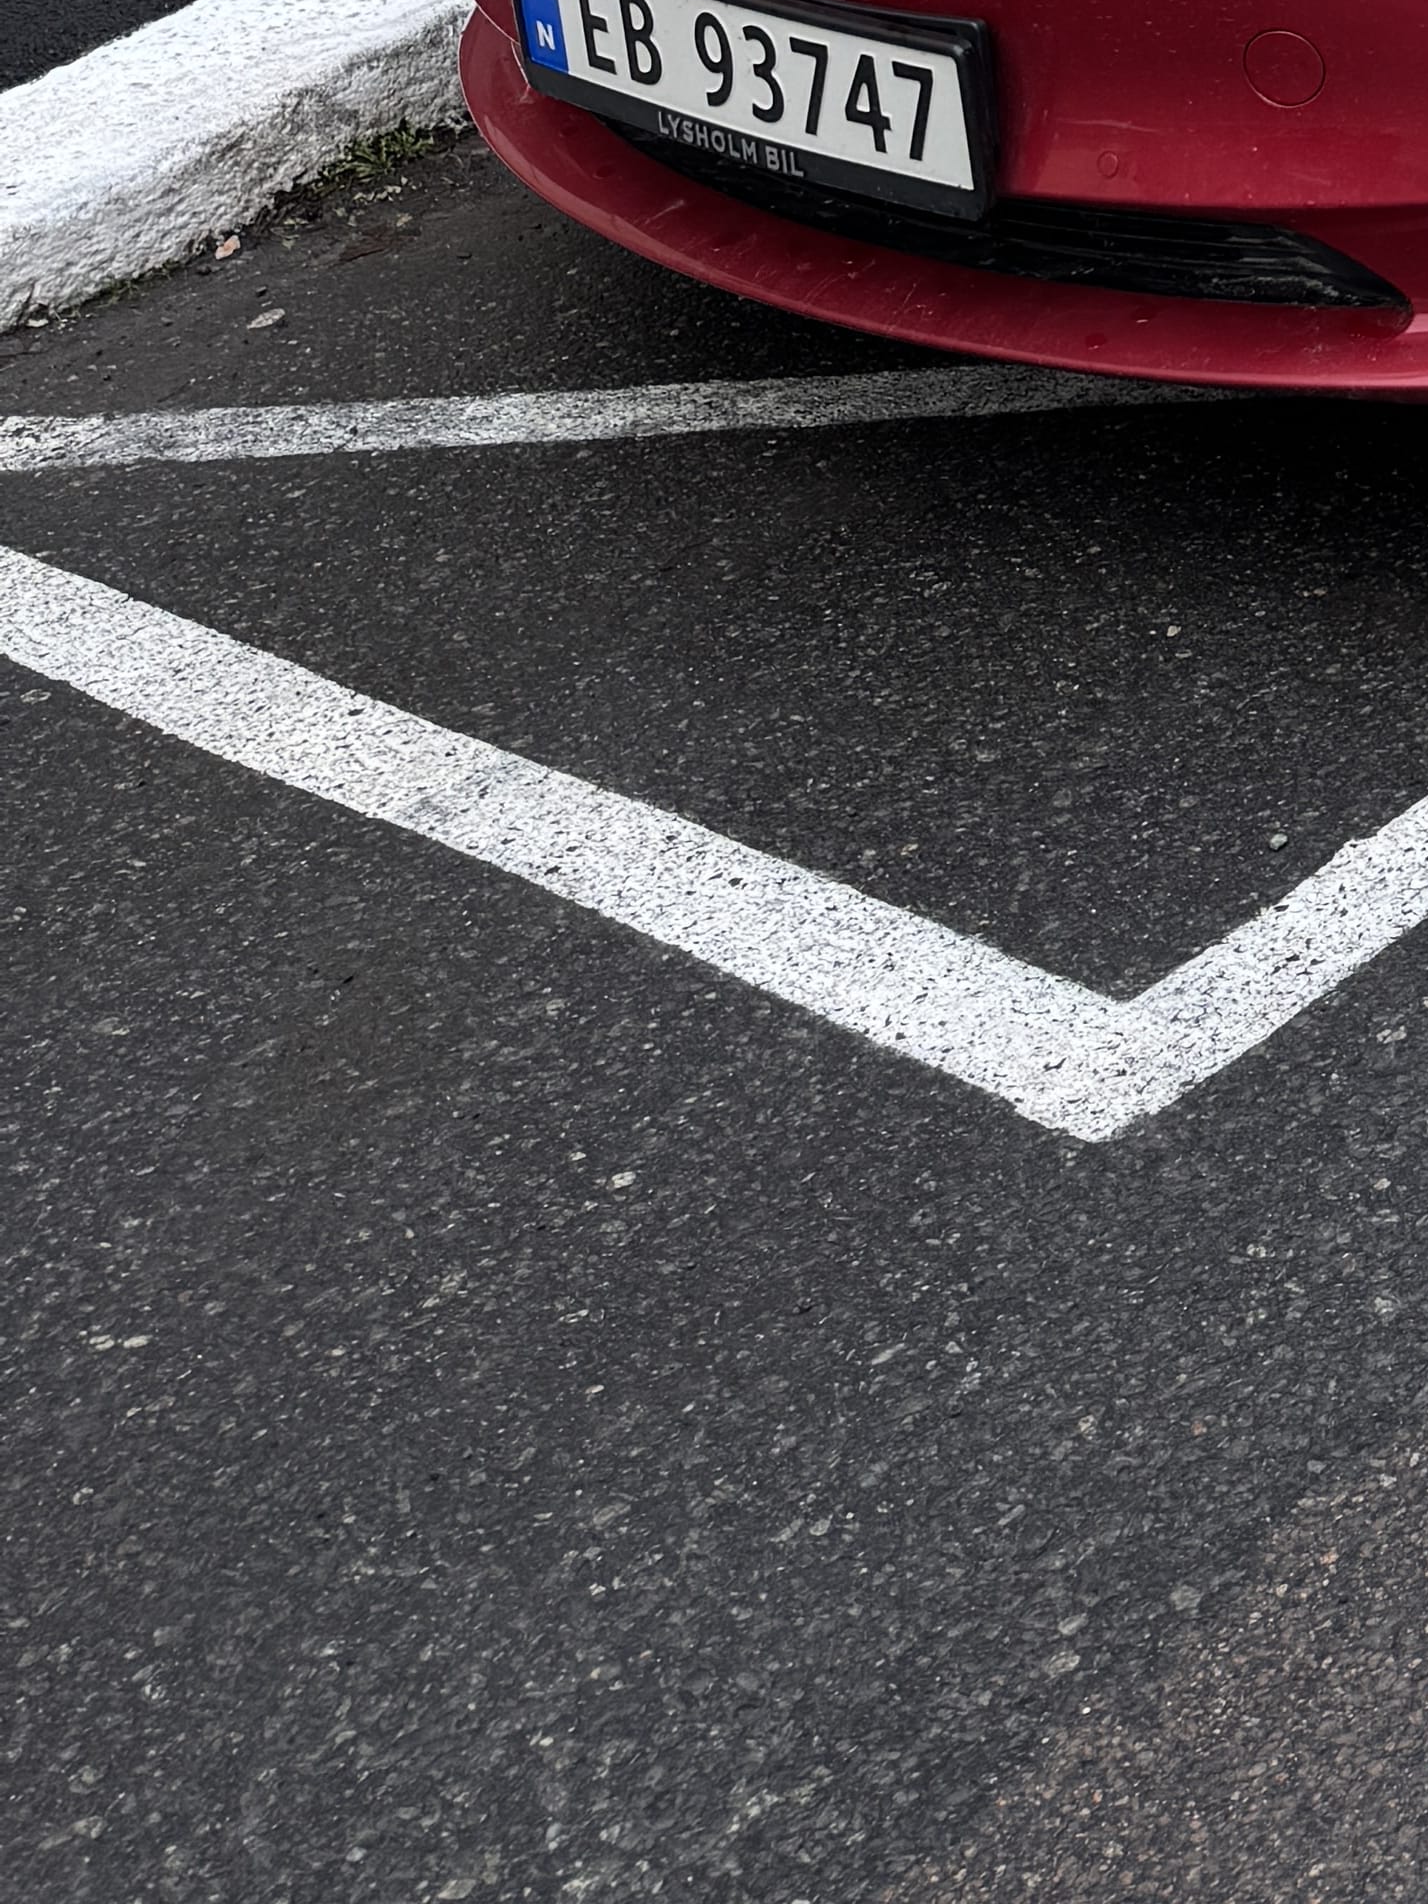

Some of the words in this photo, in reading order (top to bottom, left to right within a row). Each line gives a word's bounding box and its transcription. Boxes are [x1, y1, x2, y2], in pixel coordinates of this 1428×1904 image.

[535, 20, 556, 51] N
[694, 11, 935, 162] 93747
[657, 111, 758, 165] LYSHOLM
[765, 145, 805, 178] BIL
